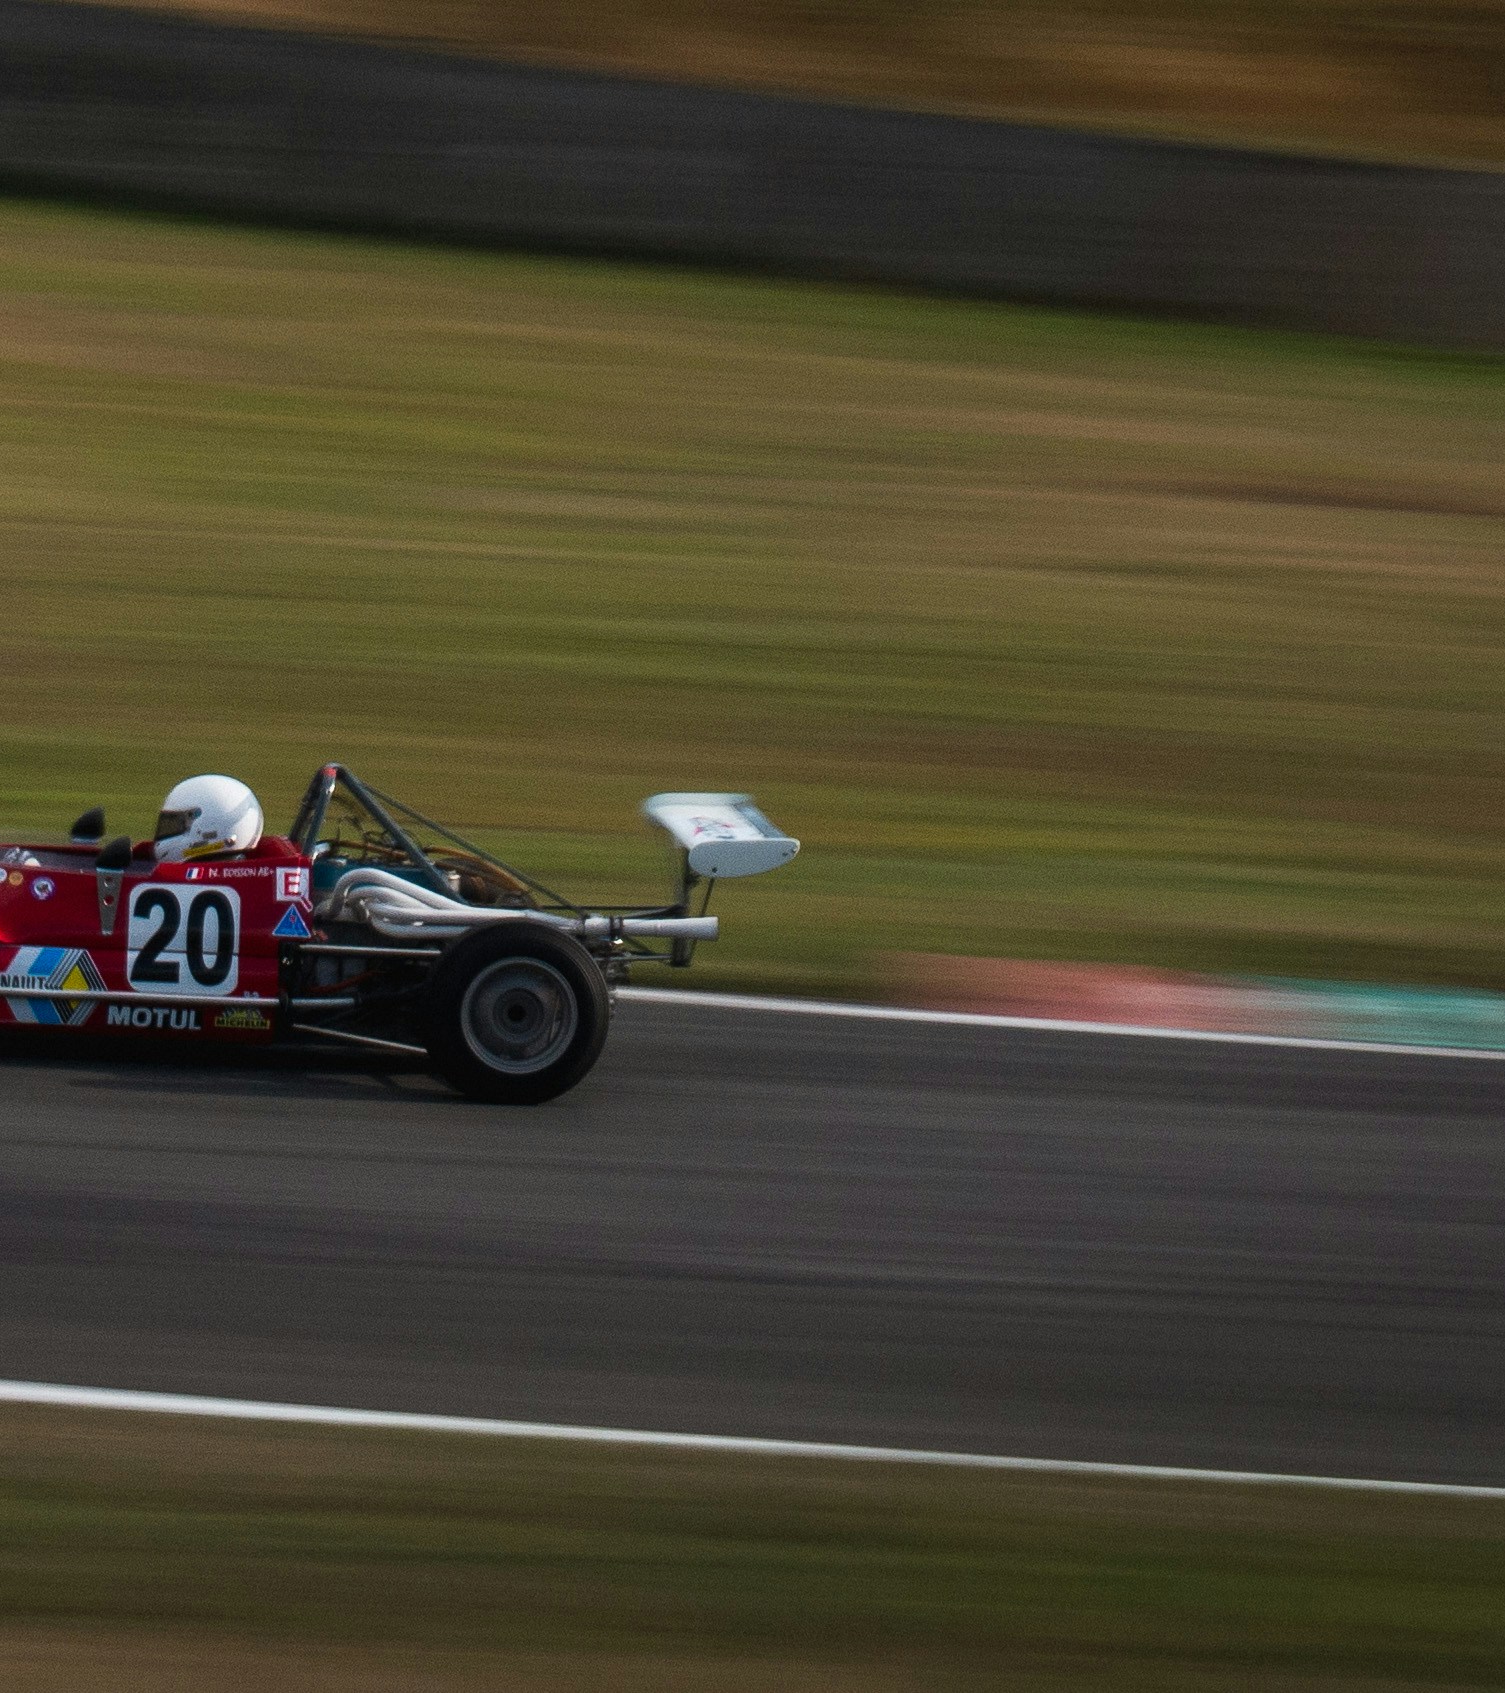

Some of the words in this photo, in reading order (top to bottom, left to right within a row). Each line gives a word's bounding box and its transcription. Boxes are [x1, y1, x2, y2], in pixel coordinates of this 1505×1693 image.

[130, 888, 235, 987] 20
[108, 1005, 201, 1030] MOTUL
[215, 1015, 269, 1029] MICHELIN
